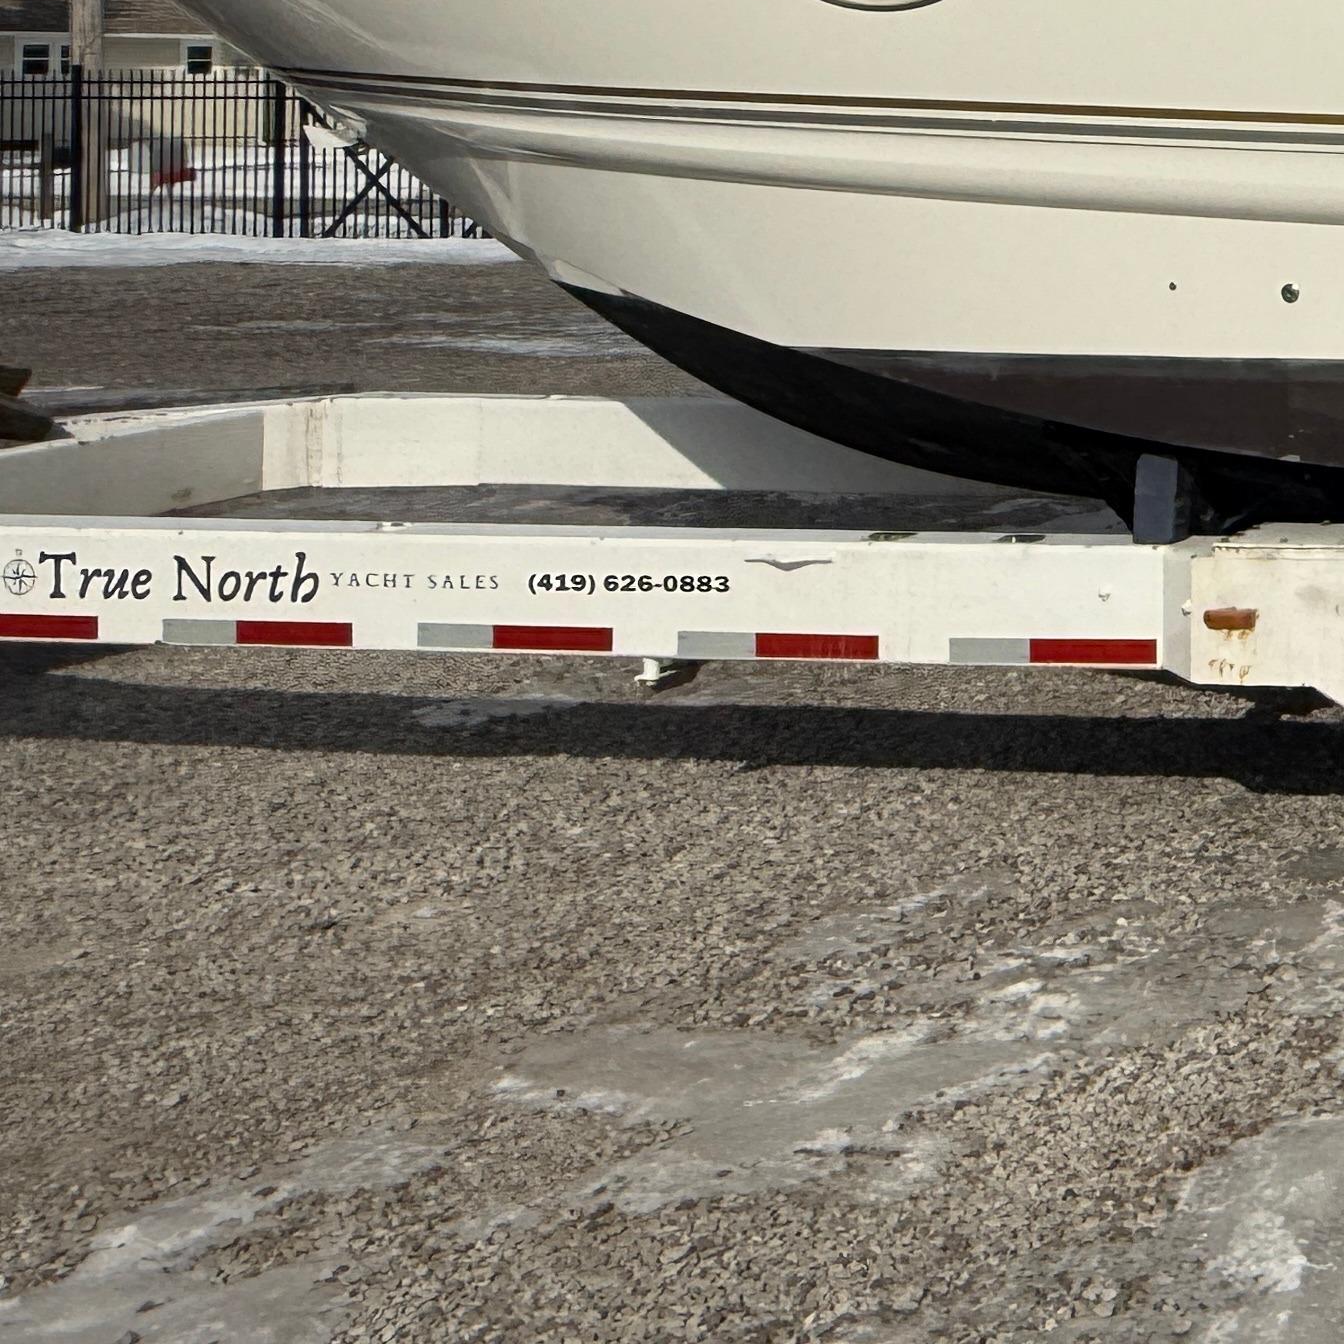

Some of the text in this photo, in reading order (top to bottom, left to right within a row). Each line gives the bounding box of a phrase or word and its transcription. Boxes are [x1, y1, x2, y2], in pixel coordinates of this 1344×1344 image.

[39, 551, 730, 603] True North YACHT SALES (419) 626-0883
